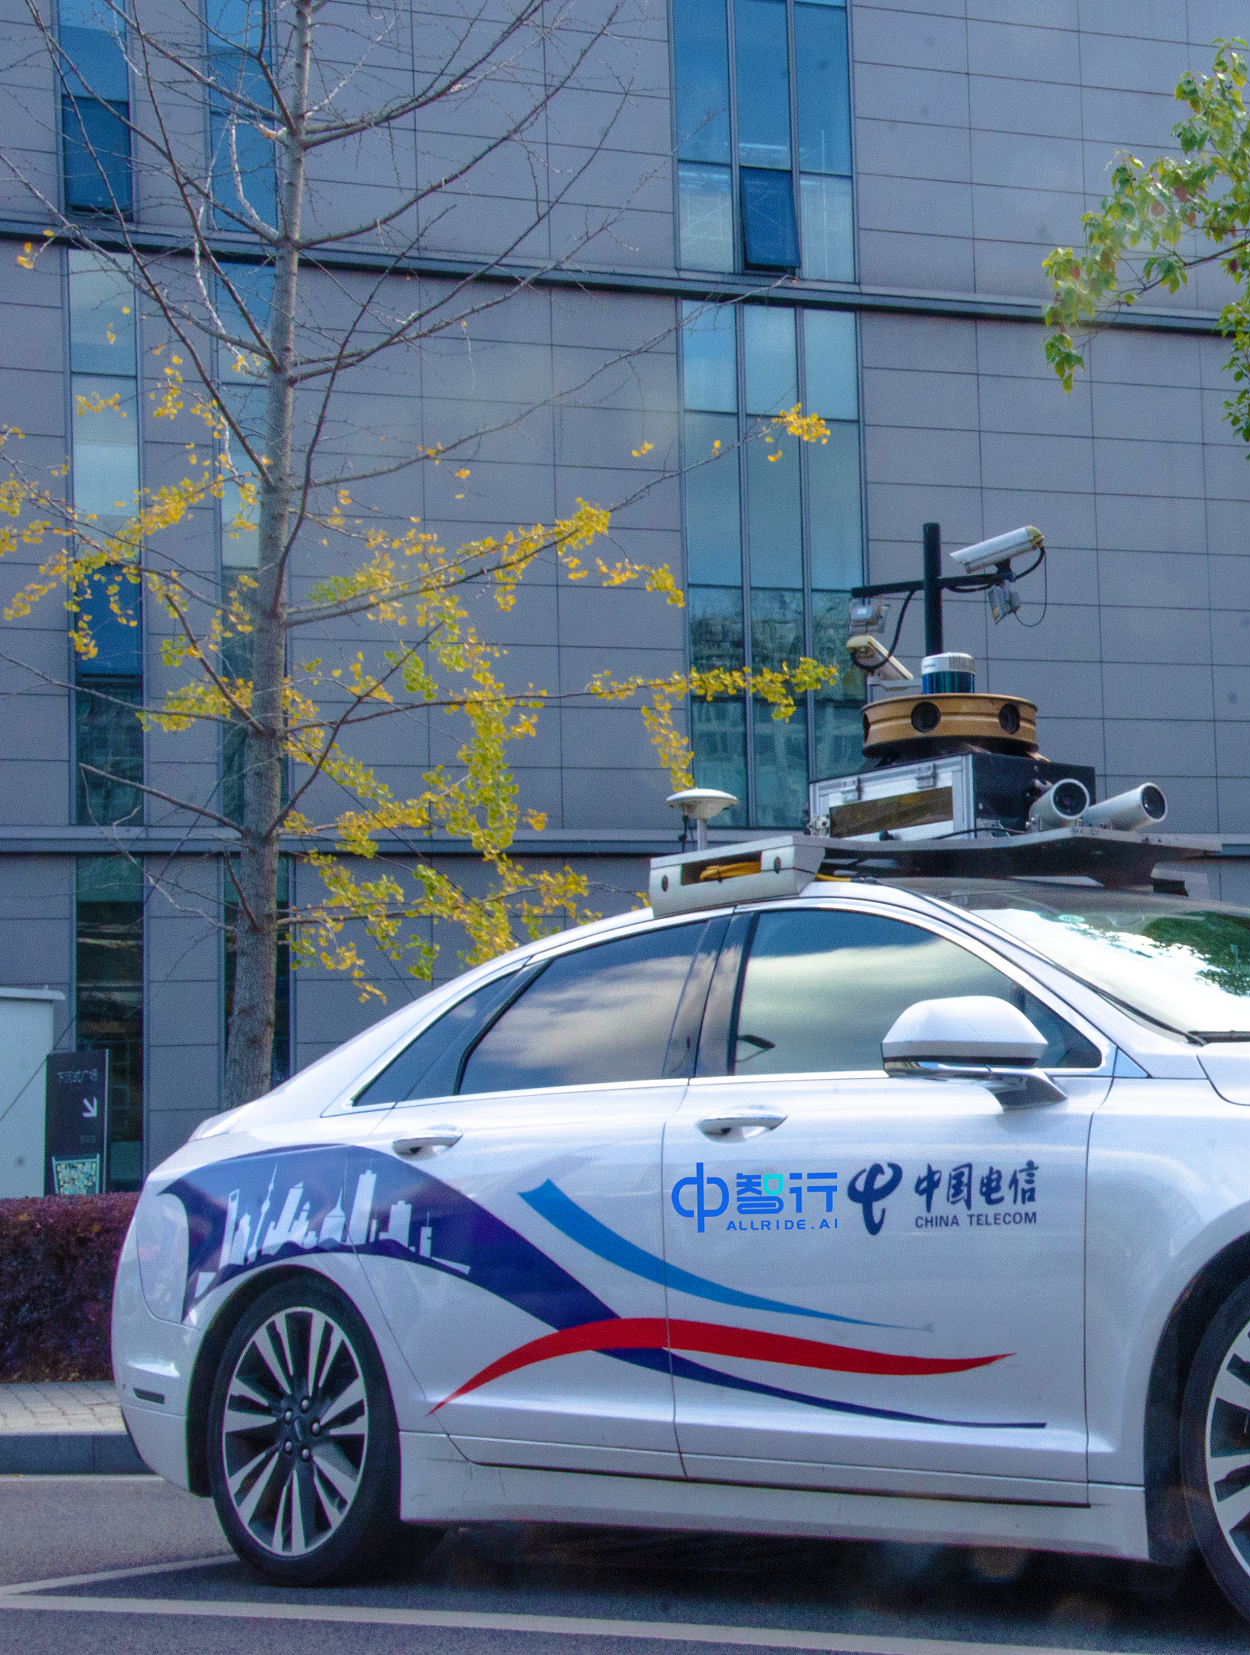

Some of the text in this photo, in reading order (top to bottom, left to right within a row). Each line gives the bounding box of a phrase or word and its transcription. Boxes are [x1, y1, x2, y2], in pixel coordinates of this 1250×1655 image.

[671, 1161, 838, 1233] 中智行
[914, 1159, 1040, 1213] 中国电信
[726, 1218, 838, 1232] ALLRIDE.AI
[915, 1211, 1038, 1229] CHINA TELECOM
